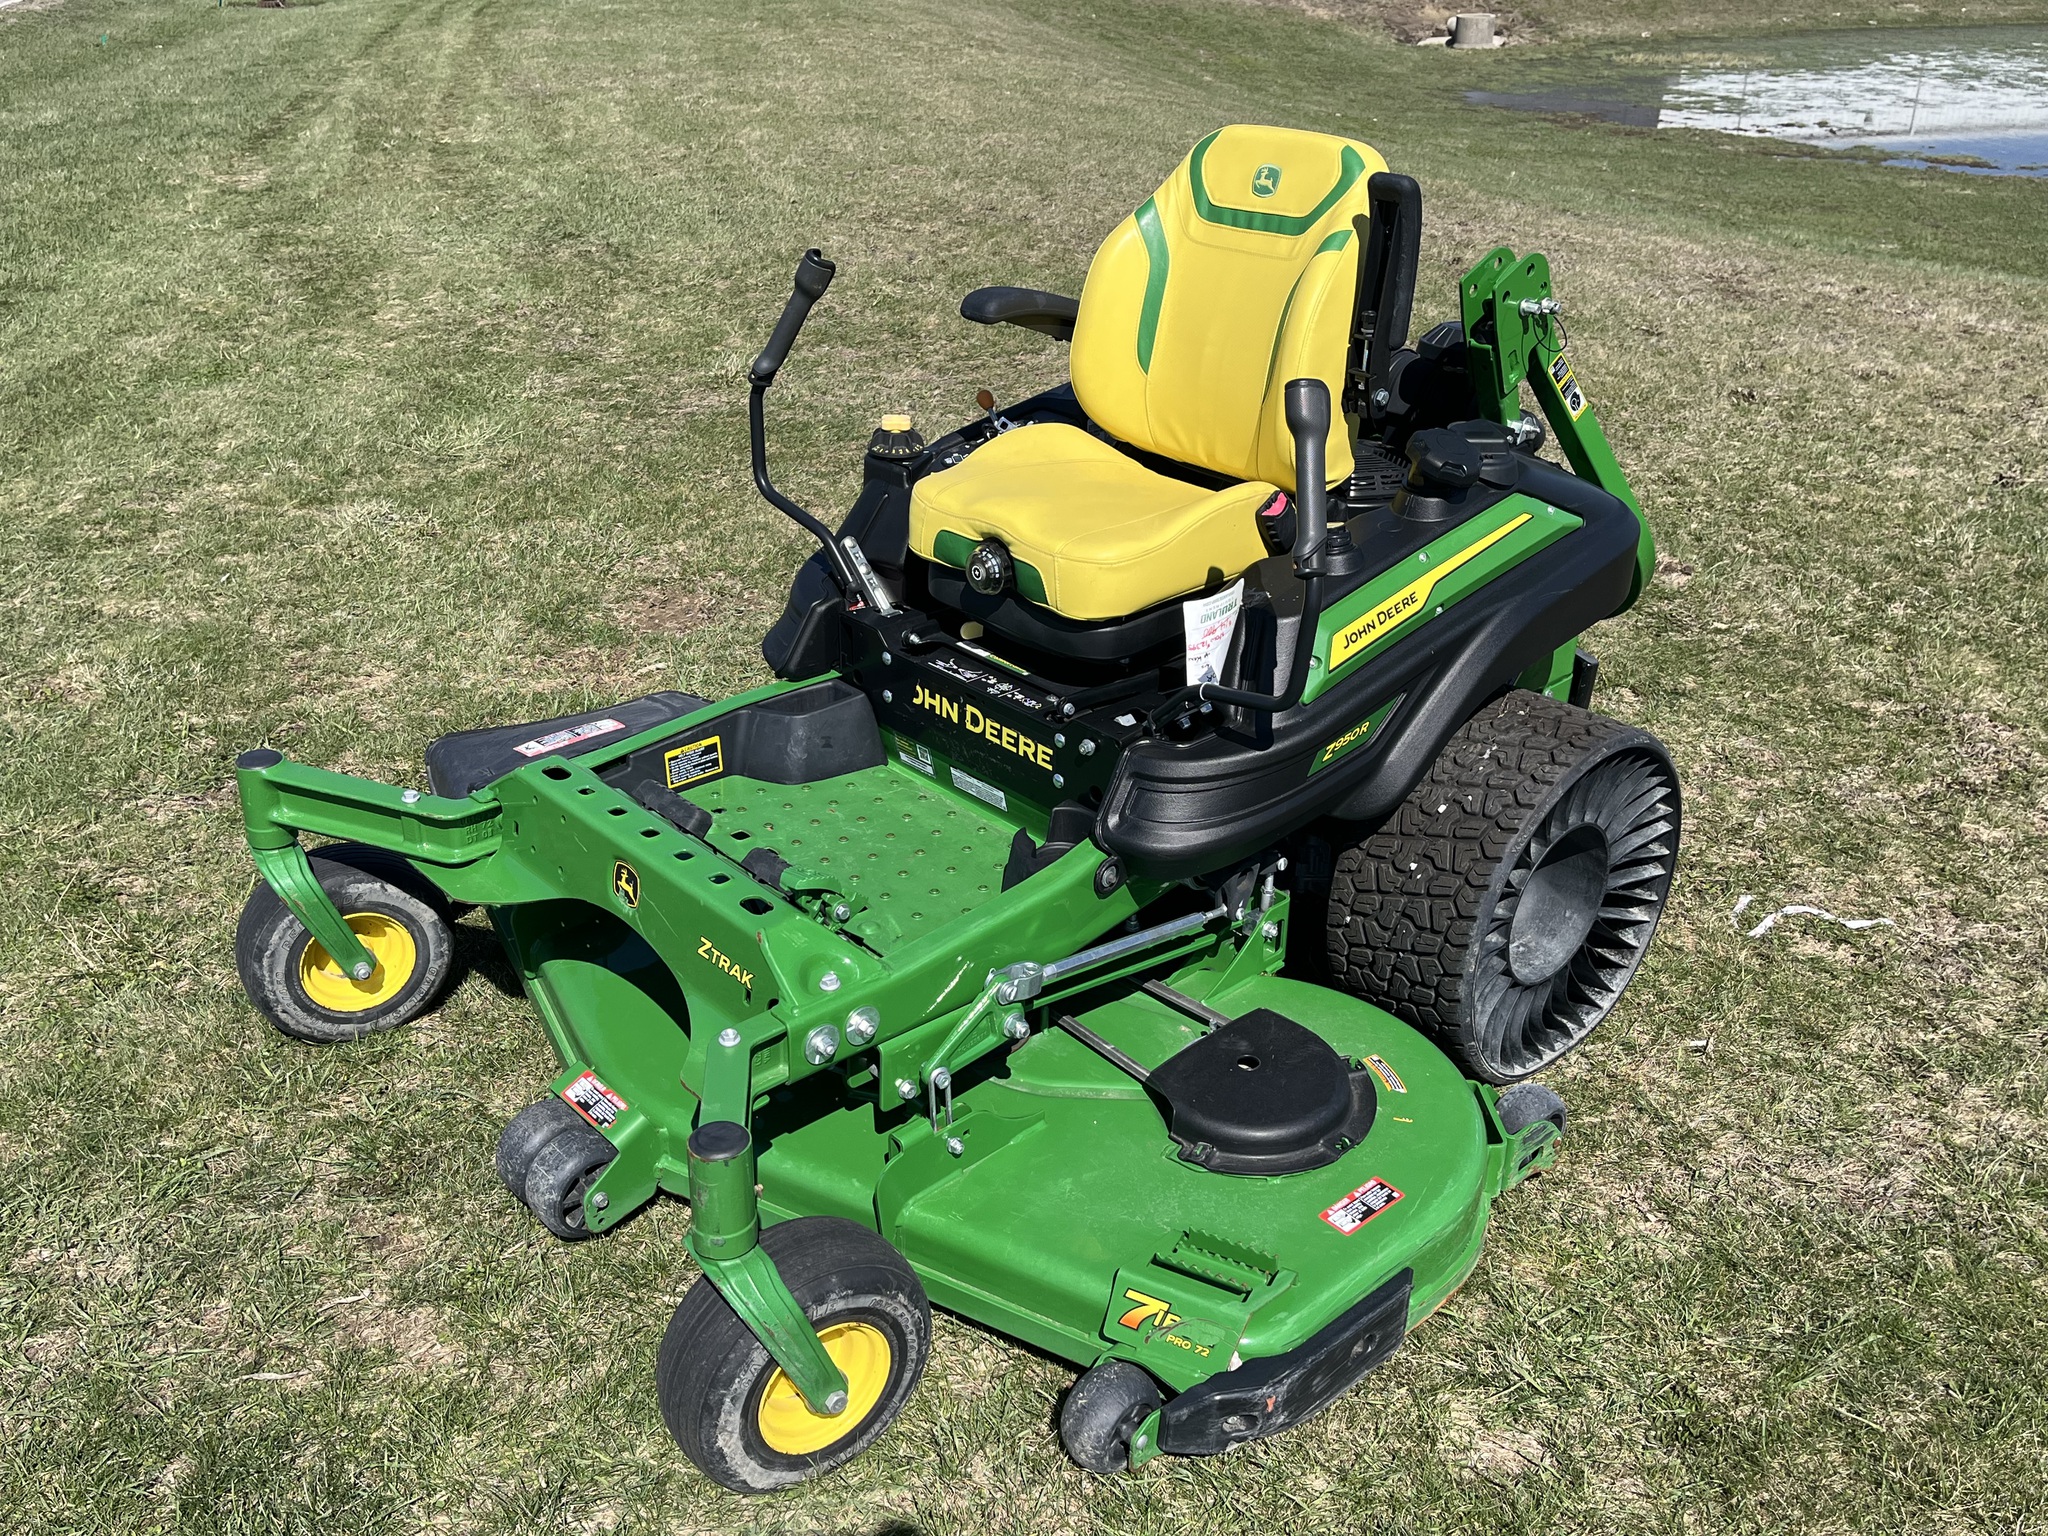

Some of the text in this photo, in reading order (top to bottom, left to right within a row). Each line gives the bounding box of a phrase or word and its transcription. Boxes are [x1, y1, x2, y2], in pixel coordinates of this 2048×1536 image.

[1201, 600, 1237, 623] TRULAND
[1343, 592, 1418, 649] JOHN DEERE
[912, 684, 959, 724] OHN
[965, 704, 1054, 771] DEERE
[1321, 721, 1370, 762] Z950R
[697, 935, 755, 990] ZTRAK
[1166, 1334, 1211, 1358] PRO 72
